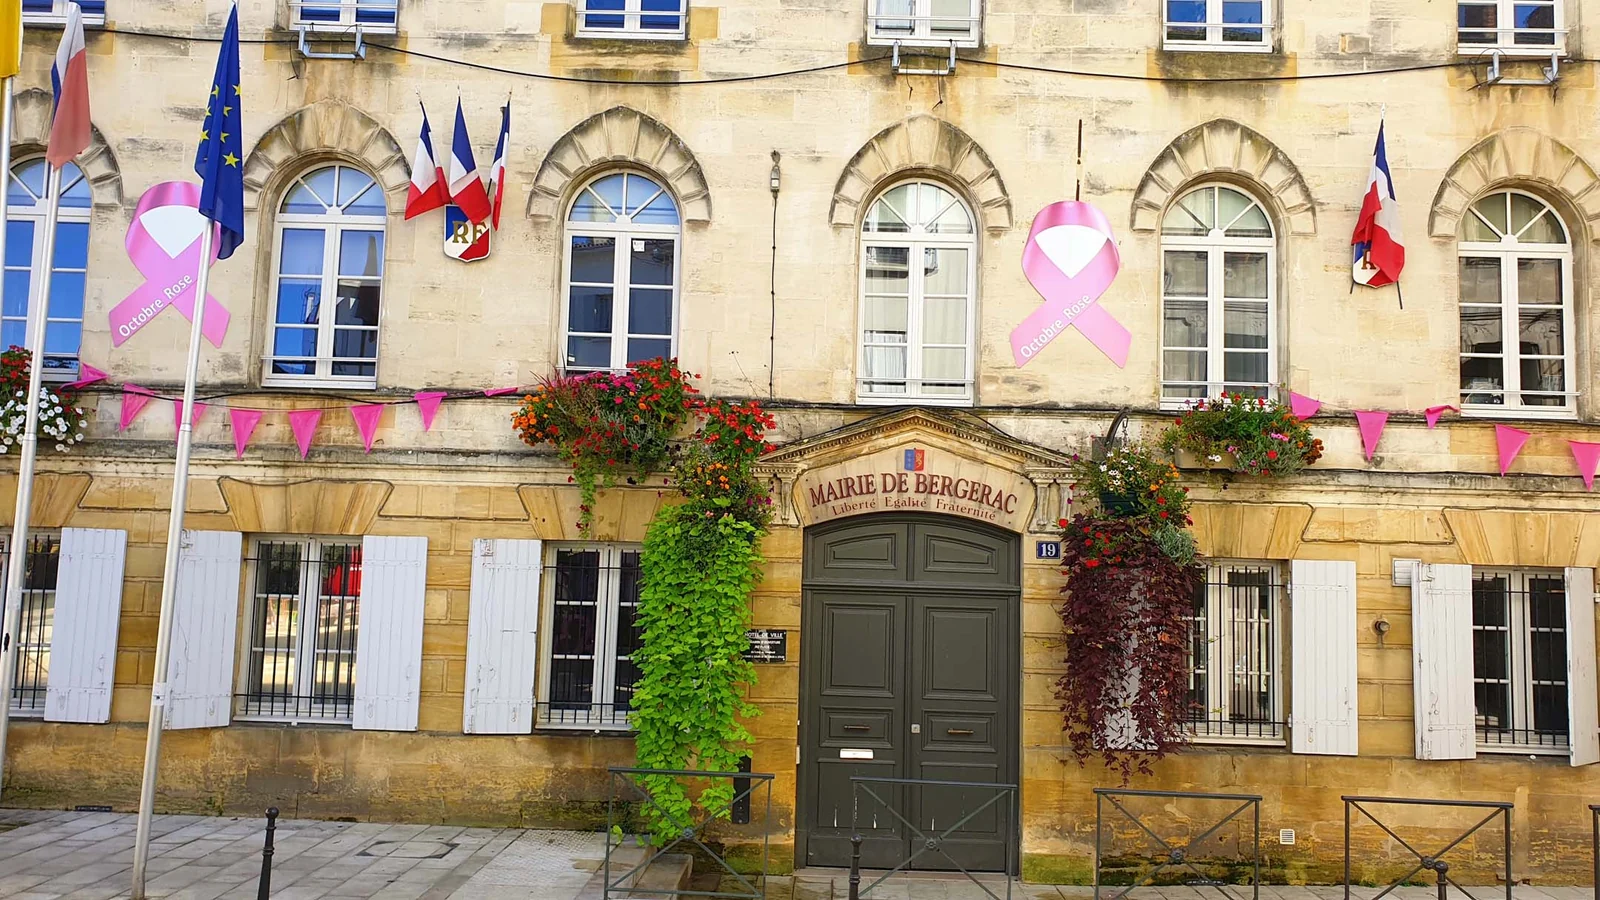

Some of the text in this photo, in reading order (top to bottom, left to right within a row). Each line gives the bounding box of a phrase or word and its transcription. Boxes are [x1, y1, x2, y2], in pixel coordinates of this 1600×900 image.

[452, 220, 487, 245] RF
[118, 274, 193, 337] Octobre Rose
[1020, 294, 1092, 358] Octobre Rose
[809, 472, 1018, 515] MAIRIE DE BERGERAC
[832, 498, 877, 516] Liberté
[936, 498, 996, 521] Fraternité
[1041, 543, 1056, 557] 19
